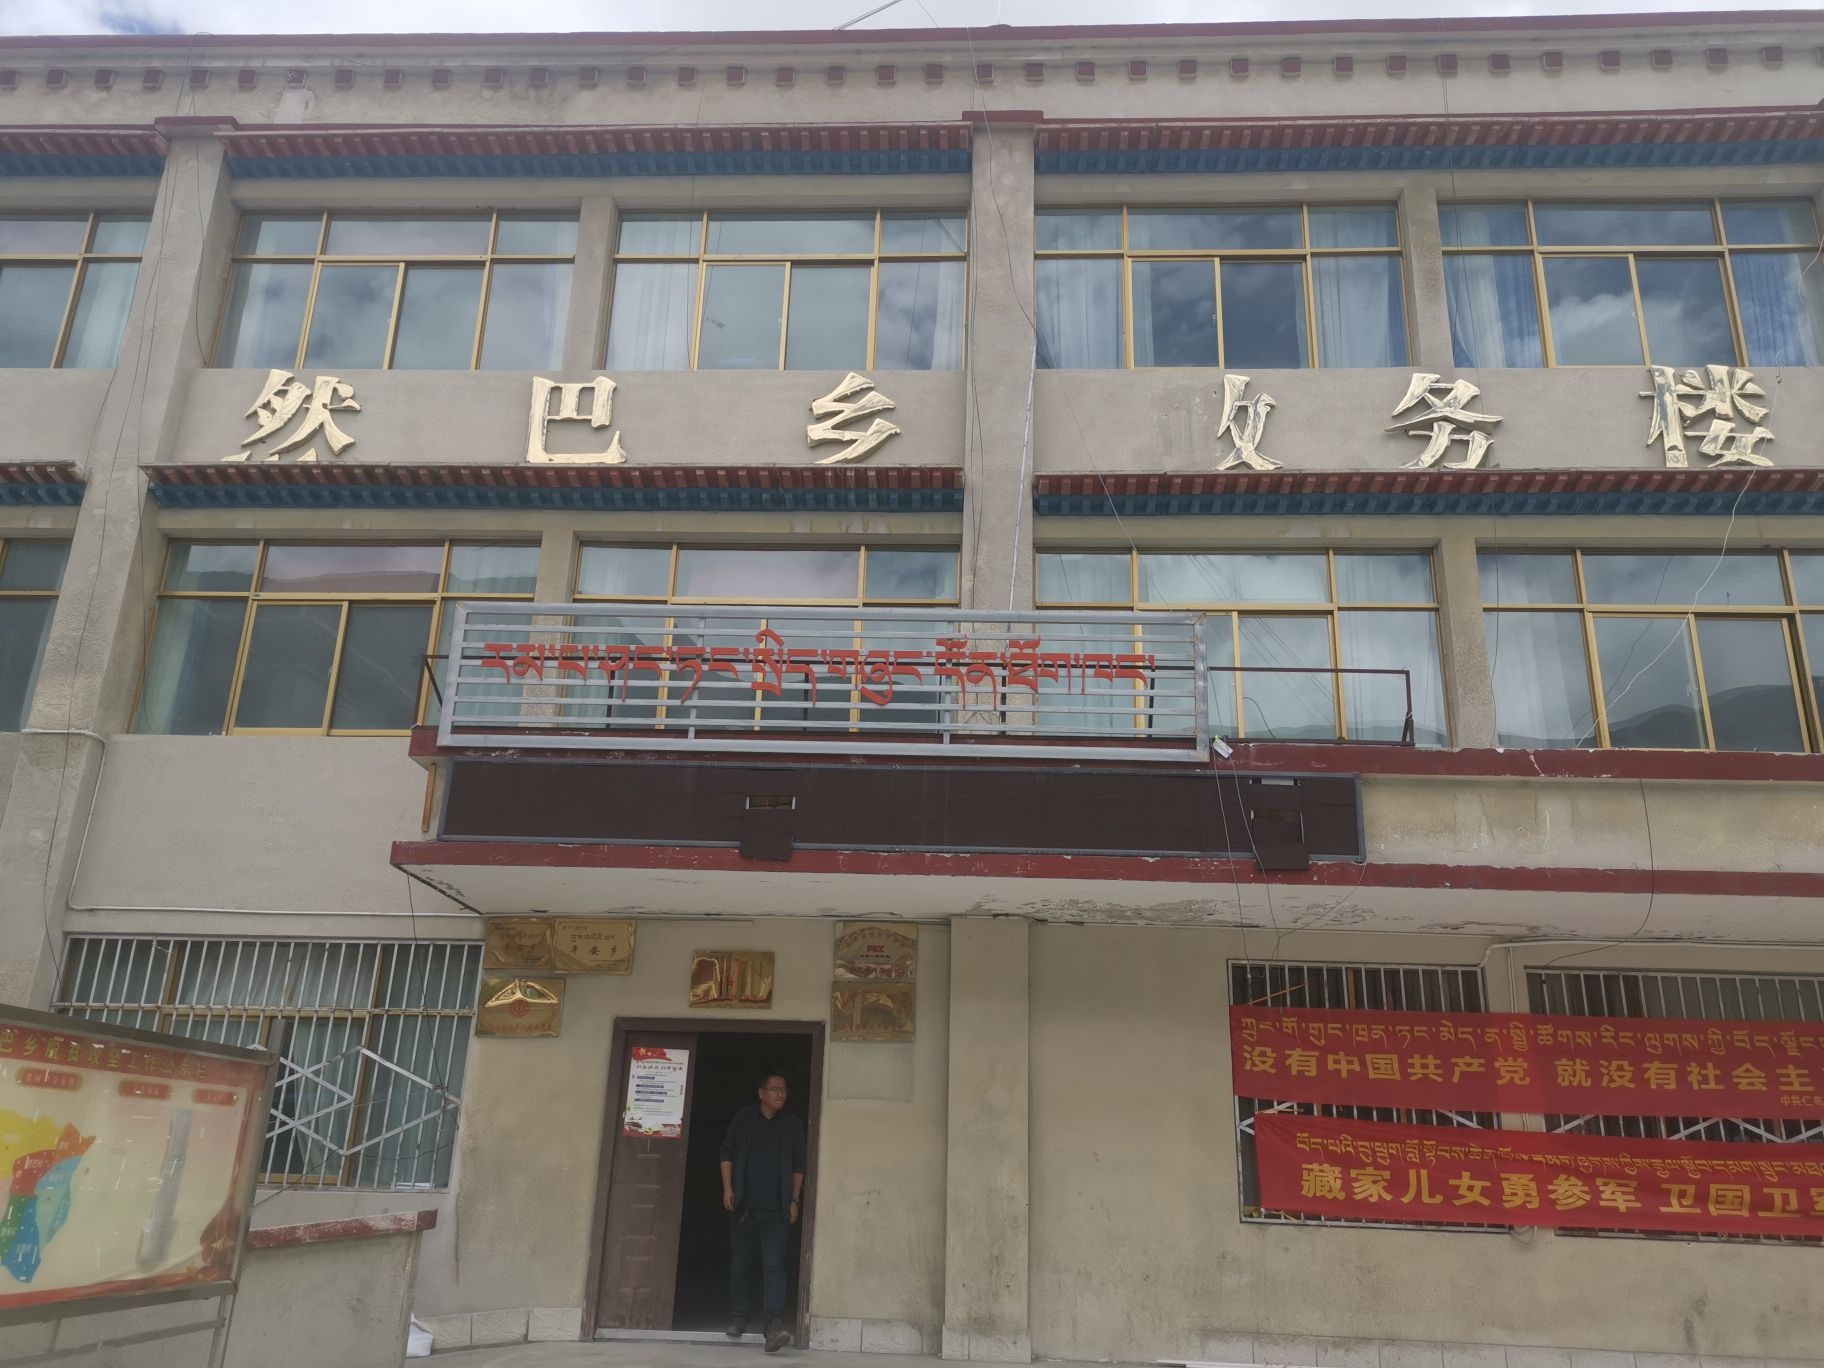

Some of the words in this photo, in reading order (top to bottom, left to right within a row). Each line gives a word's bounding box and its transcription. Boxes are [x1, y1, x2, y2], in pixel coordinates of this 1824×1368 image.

[1243, 1044, 1530, 1086] 没有中国共产党
[1555, 1057, 1824, 1092] 就没有社会主
[1301, 1162, 1642, 1213] 藏家儿女勇参军
